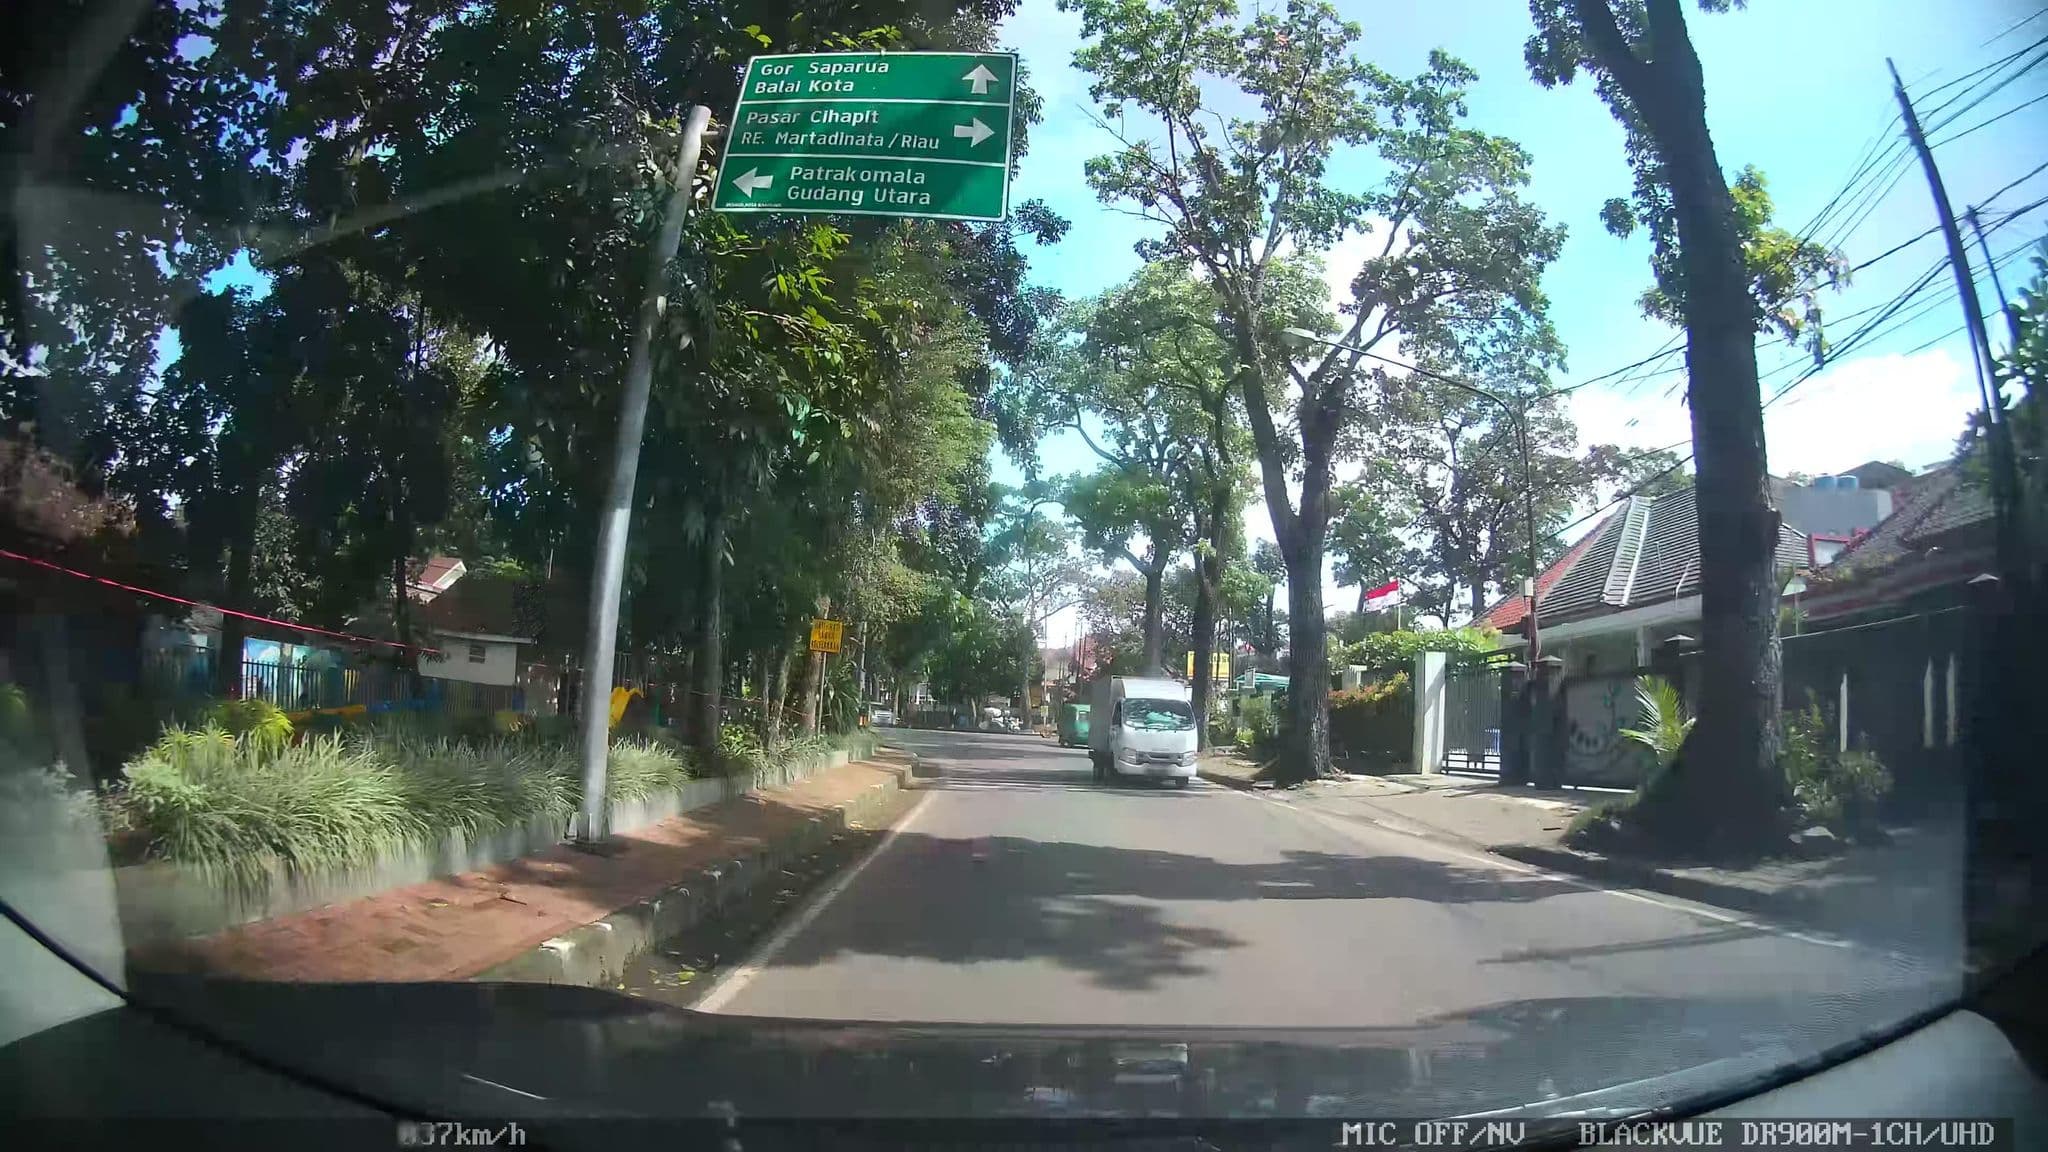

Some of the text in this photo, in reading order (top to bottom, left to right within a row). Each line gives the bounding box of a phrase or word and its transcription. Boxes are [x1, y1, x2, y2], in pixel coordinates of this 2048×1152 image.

[760, 61, 889, 76] Gor Saparua
[754, 79, 854, 94] Balai Kota
[746, 110, 880, 126] Pasar Cihapit
[741, 131, 765, 145] RE.
[789, 166, 926, 185] Patrakomala
[787, 185, 931, 206] Gudang Utara
